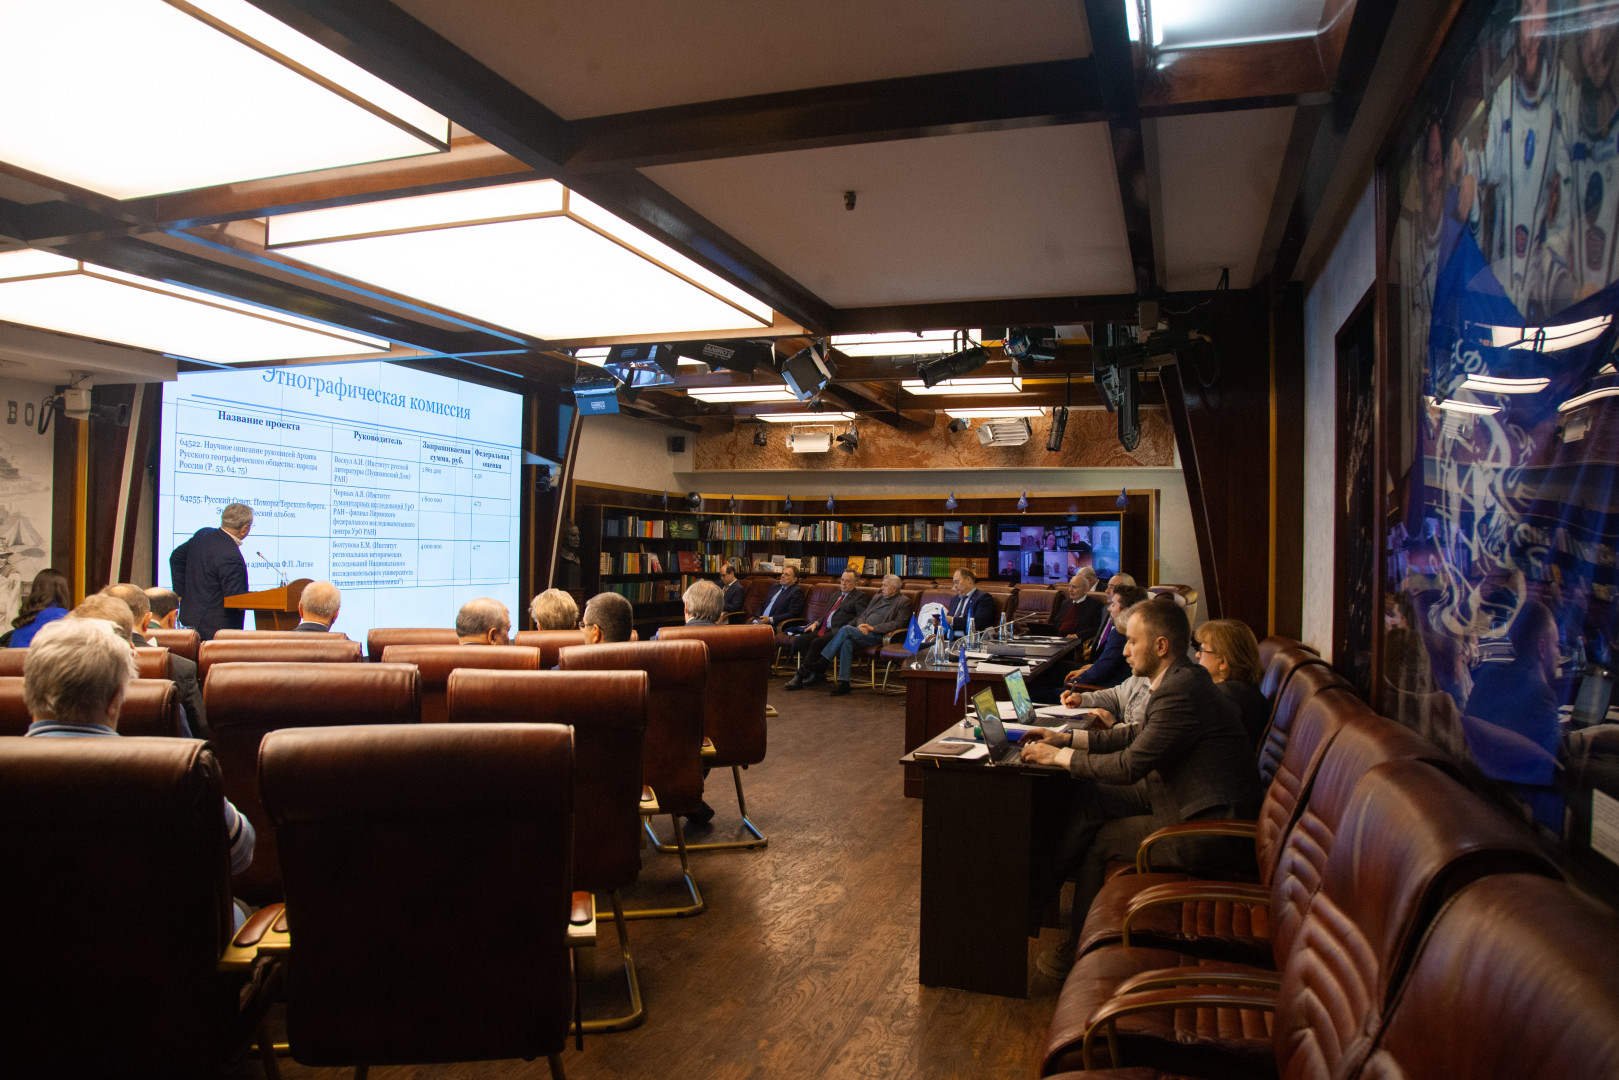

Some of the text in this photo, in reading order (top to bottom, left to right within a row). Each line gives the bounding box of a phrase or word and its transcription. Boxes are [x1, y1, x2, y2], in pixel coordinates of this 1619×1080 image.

[262, 368, 471, 420] Этнографическая комиссия
[218, 411, 301, 431] Название проекта
[353, 431, 403, 446] Руководитель
[180, 439, 317, 461] 64522. Научное описание рукописей Архива
[422, 441, 471, 455] Запрашиваемая
[474, 449, 510, 461] Федеральная
[180, 449, 210, 462] Русского
[211, 454, 264, 466] географического
[296, 463, 318, 471] народы
[180, 460, 204, 470] России
[365, 460, 390, 470] (Институт
[430, 455, 464, 465] сумма, руб.
[482, 461, 502, 470] оценка
[334, 475, 348, 484] РАН)
[180, 494, 202, 504] 64255.
[204, 496, 231, 506] Русский
[280, 500, 306, 509] Терского
